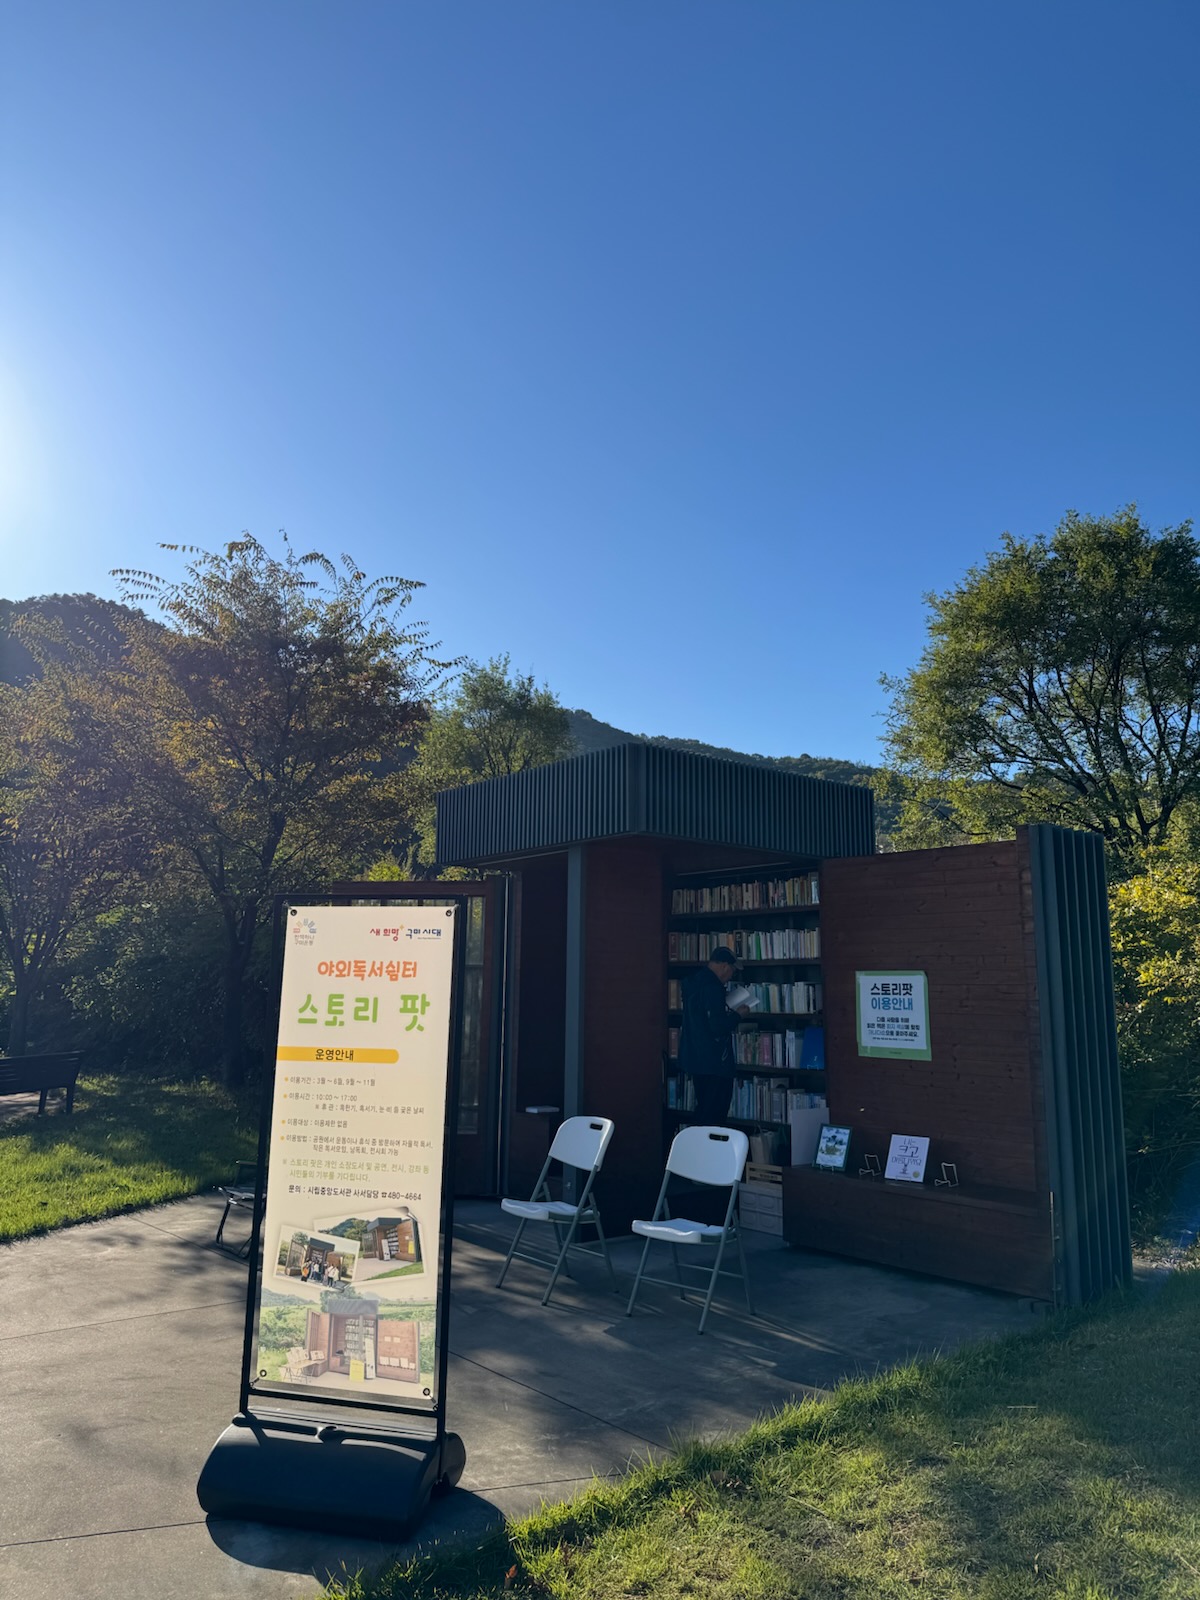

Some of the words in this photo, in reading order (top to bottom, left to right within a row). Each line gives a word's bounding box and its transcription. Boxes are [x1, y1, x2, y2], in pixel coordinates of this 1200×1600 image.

[369, 928, 381, 937] 새
[383, 928, 400, 942] 희망
[405, 928, 421, 940] 구미
[422, 928, 442, 937] 시대
[317, 959, 418, 981] 야외독서쉼터
[871, 983, 913, 996] 스토리팟
[871, 997, 913, 1011] 이용안내
[297, 993, 379, 1027] 스토리
[399, 993, 431, 1032] 팟
[315, 1048, 354, 1061] 운영안내
[290, 1076, 312, 1085] 이용기간
[317, 1076, 326, 1085] 3월
[363, 1079, 375, 1087] 11월
[289, 1092, 311, 1101] 이용시간
[316, 1093, 332, 1101] 10:00
[341, 1094, 358, 1102] 17:00
[413, 1106, 425, 1115] 날씨
[287, 1118, 309, 1127] 이용대상
[314, 1119, 336, 1128] 이용제한
[337, 1120, 347, 1129] 없음
[286, 1134, 307, 1142] 이용방법
[313, 1135, 335, 1144] 공원에서
[359, 1137, 370, 1145] 휴식
[378, 1138, 401, 1147] 방문하여
[402, 1139, 419, 1148] 자율적
[370, 1147, 386, 1155] 전시회
[387, 1148, 399, 1157] 가능
[289, 1159, 308, 1167] 스토리
[310, 1159, 323, 1168] 팟은
[324, 1160, 337, 1169] 개인
[338, 1161, 364, 1170] 소장도서
[289, 1169, 314, 1179] 시민들의
[316, 1170, 335, 1180] 기부를
[288, 1184, 301, 1194] 문의
[308, 1186, 352, 1197] 시립중앙도서관
[353, 1188, 379, 1199] 사서담당
